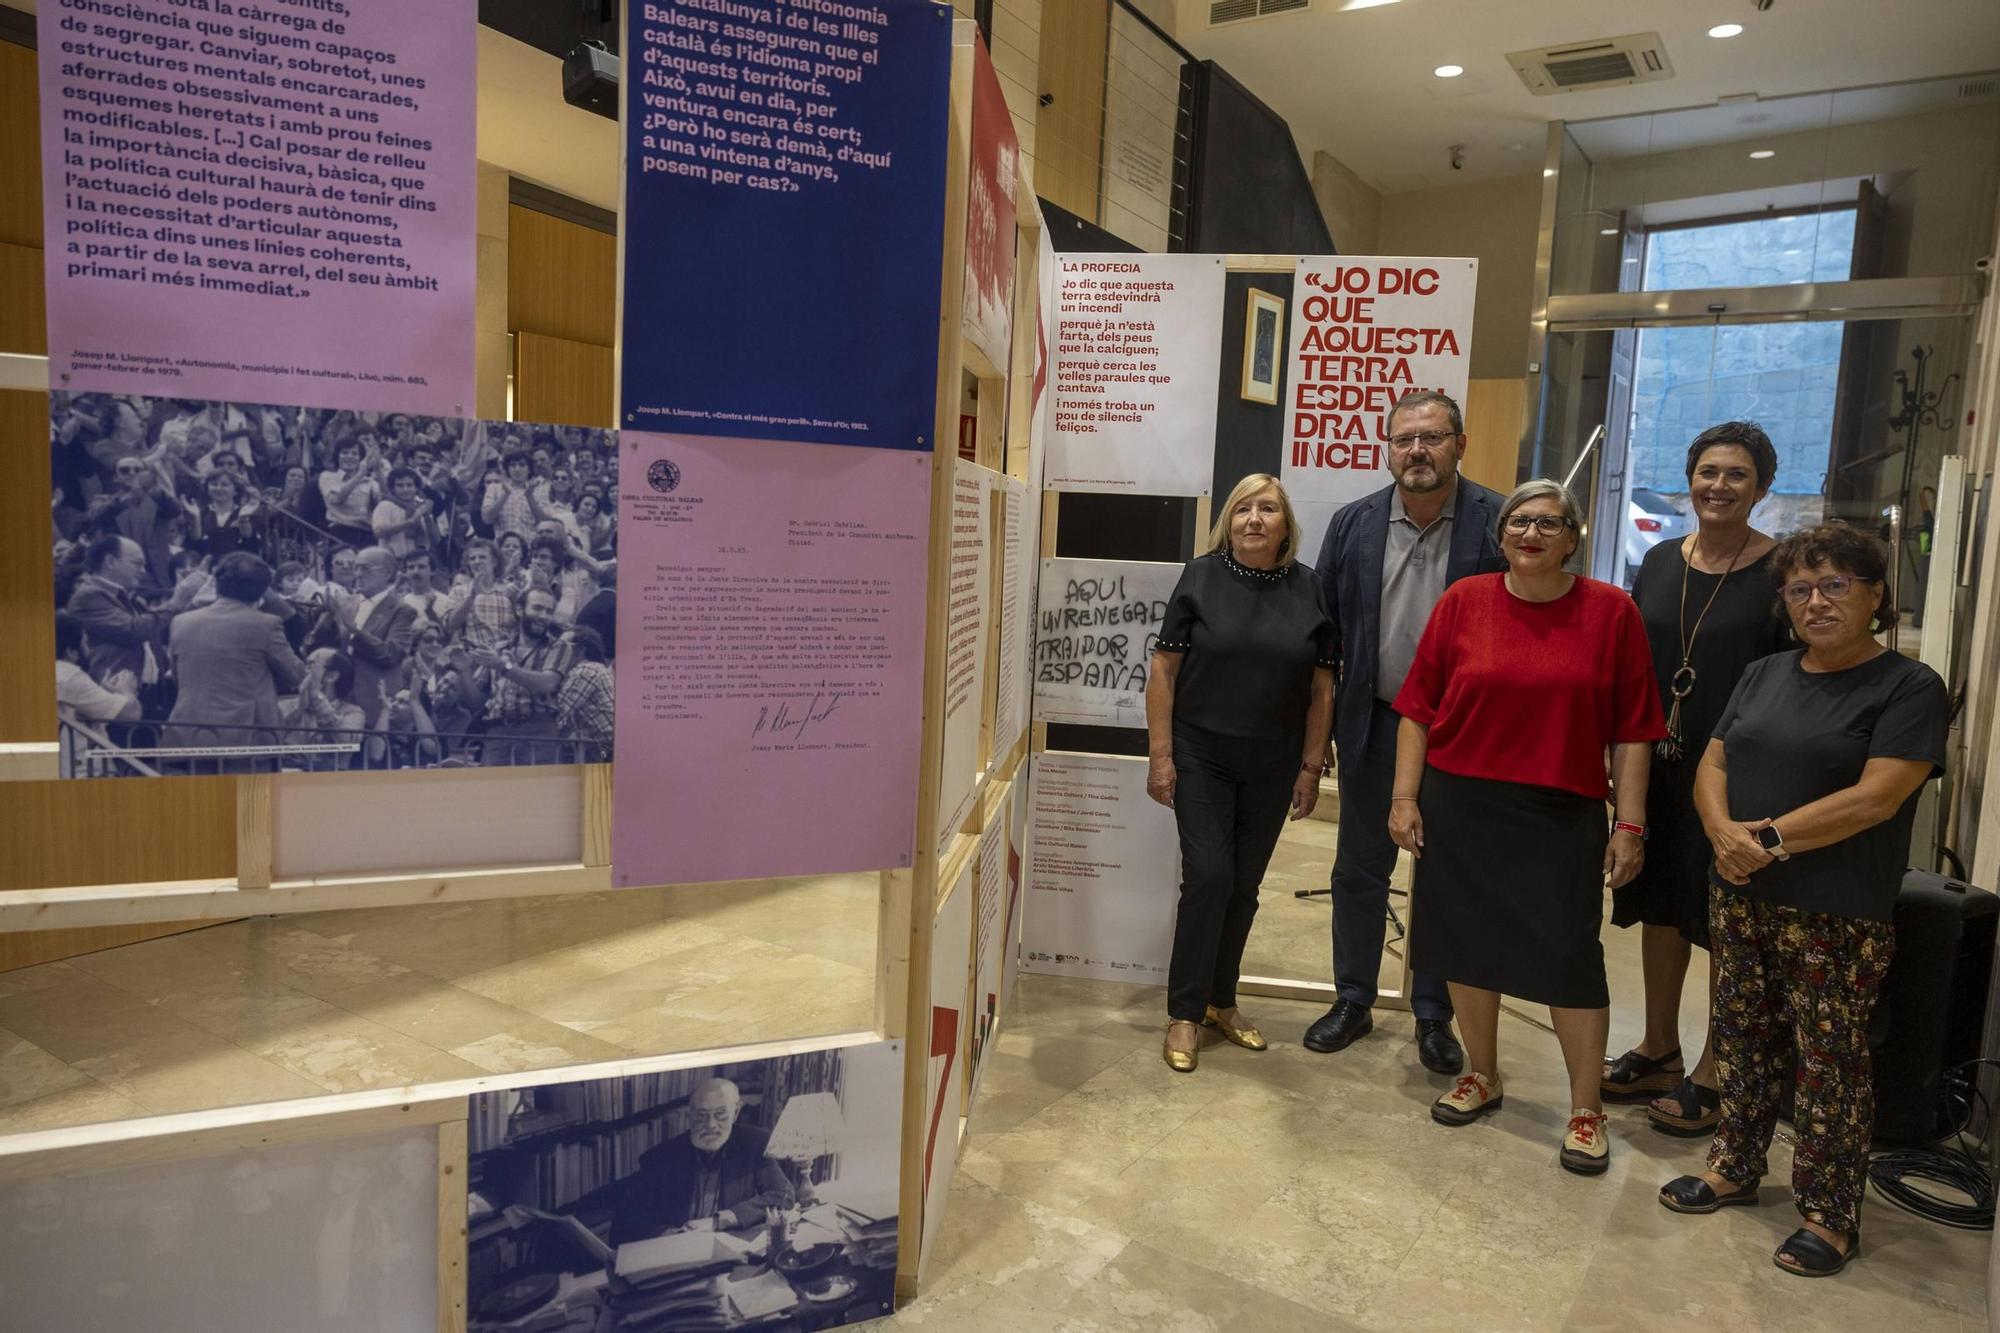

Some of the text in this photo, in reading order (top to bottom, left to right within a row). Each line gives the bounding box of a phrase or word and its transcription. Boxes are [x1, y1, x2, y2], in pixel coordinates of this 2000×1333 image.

[776, 0, 888, 26] autonomia
[776, 8, 780, 24] i
[786, 11, 808, 29] de
[813, 16, 838, 35] les
[843, 22, 878, 43] Illes
[644, 4, 877, 64] Balears asseguren que el
[644, 29, 861, 84] català és l’idioma propi
[643, 47, 830, 96] d’aquests territoris.
[643, 68, 836, 118] Això, avui en dia, per
[643, 93, 860, 144] ventura encara és cert;
[643, 111, 890, 168] ¿Però ho serà demà, d’aquí
[643, 135, 838, 182] a una vintena d’anys,
[65, 149, 435, 212] la política cultural haurà de tenir dins
[643, 156, 799, 192] posem per cas?»
[66, 193, 401, 247] i la necessitat d’articular aquesta
[67, 218, 410, 271] política dins unes línies coherents,
[67, 241, 437, 290] a partir de la seva arrel, del seu àmbit
[68, 261, 310, 298] primari més immediat.»
[1063, 263, 1140, 273] LA PROFECIA
[1062, 279, 1173, 293] Jo dic que aquesta
[1304, 267, 1440, 296] «JO DIC
[1061, 303, 1121, 314] un incendi
[1062, 291, 1160, 303] terra esdevindrà
[1302, 296, 1375, 323] QUE
[1060, 320, 1154, 333] perquè ja n’està
[1060, 331, 1152, 345] farta, dels peus
[1300, 326, 1460, 356] AQUESTA
[1059, 343, 1158, 357] que la calciguen;
[1058, 360, 1156, 372] perquè cerca les
[1058, 371, 1170, 386] velles paraules que
[1299, 355, 1414, 384] TERRA
[1057, 384, 1104, 394] cantava
[1056, 411, 1142, 423] pou de silencis
[1062, 400, 1101, 410] només
[1105, 401, 1136, 411] troba
[1140, 404, 1154, 412] un
[1055, 421, 1097, 435] feliços.
[1294, 410, 1367, 440] DRÀ
[1065, 576, 1127, 605] AQUI
[1043, 601, 1168, 632] UN RENEGAD
[1037, 634, 1128, 661] TRAIDOR
[1039, 658, 1147, 692] ESPAÑA
